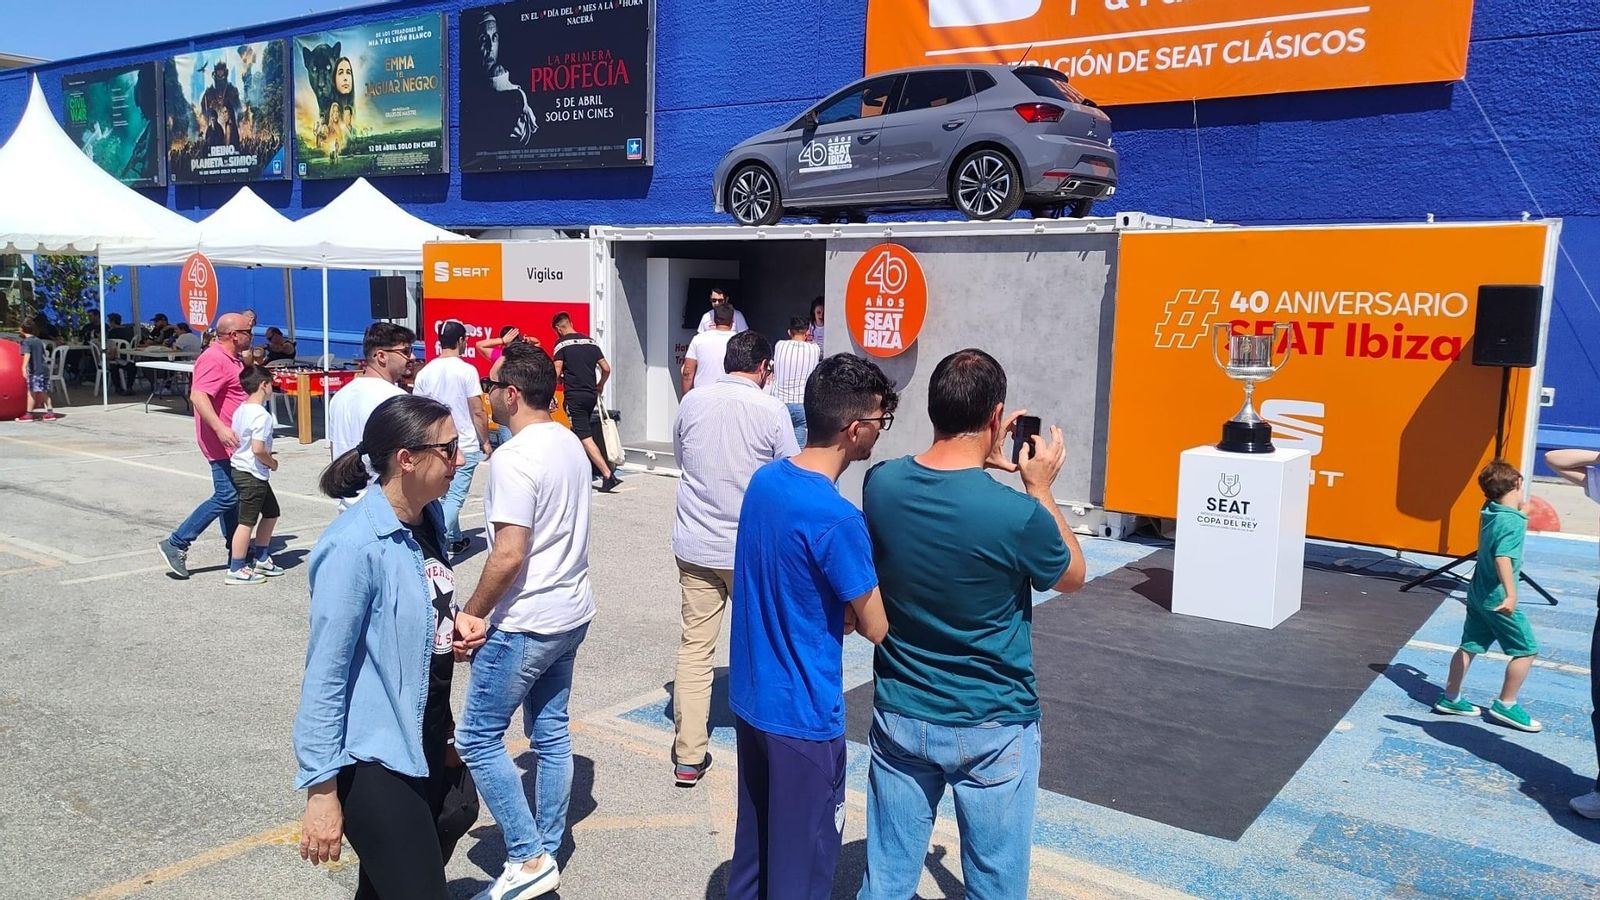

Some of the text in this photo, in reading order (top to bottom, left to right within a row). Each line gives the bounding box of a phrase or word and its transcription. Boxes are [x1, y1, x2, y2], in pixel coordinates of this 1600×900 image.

[521, 13, 530, 21] EN
[530, 12, 539, 20] EL
[547, 8, 559, 17] DÍA
[561, 7, 573, 16] DEL
[582, 3, 596, 13] MES
[598, 3, 603, 11] A
[604, 1, 614, 10] LA
[567, 13, 594, 25] NACERÁ
[408, 31, 432, 41] BLANCO
[548, 50, 612, 65] LA PRIMERA
[1118, 49, 1149, 73] DE
[1155, 43, 1218, 70] SEAT
[1222, 28, 1367, 64] CLÁSICOS
[384, 55, 415, 72] EMMA
[530, 59, 630, 93] PROFECÍA
[364, 75, 438, 97] JAGUAR NEGRO
[556, 95, 603, 108] 5 DE ABRIL
[545, 107, 614, 122] SOLO EN CINES
[397, 142, 412, 150] SOLO
[421, 140, 436, 148] CINES
[828, 144, 851, 156] SEAT
[798, 140, 827, 167] 40
[828, 153, 852, 166] IBIZA
[191, 157, 223, 172] PLANETA
[228, 155, 258, 167] SIMIOS
[188, 258, 208, 288] 40
[452, 267, 490, 278] SEAT
[527, 267, 564, 283] Vigilsa
[865, 251, 908, 294] 40
[189, 300, 208, 314] SEAT
[865, 295, 905, 308] AÑOS
[1230, 290, 1270, 313] 40
[1274, 291, 1468, 318] ANIVERSARIO
[190, 312, 209, 326] IBIZA
[864, 312, 903, 331] SEAT
[863, 330, 903, 350] IBIZA
[1344, 322, 1463, 362] Ibiza
[1206, 497, 1250, 515] SEAT
[1197, 515, 1221, 525] COPA
[1223, 518, 1239, 527] DEL
[1241, 520, 1258, 529] REY
